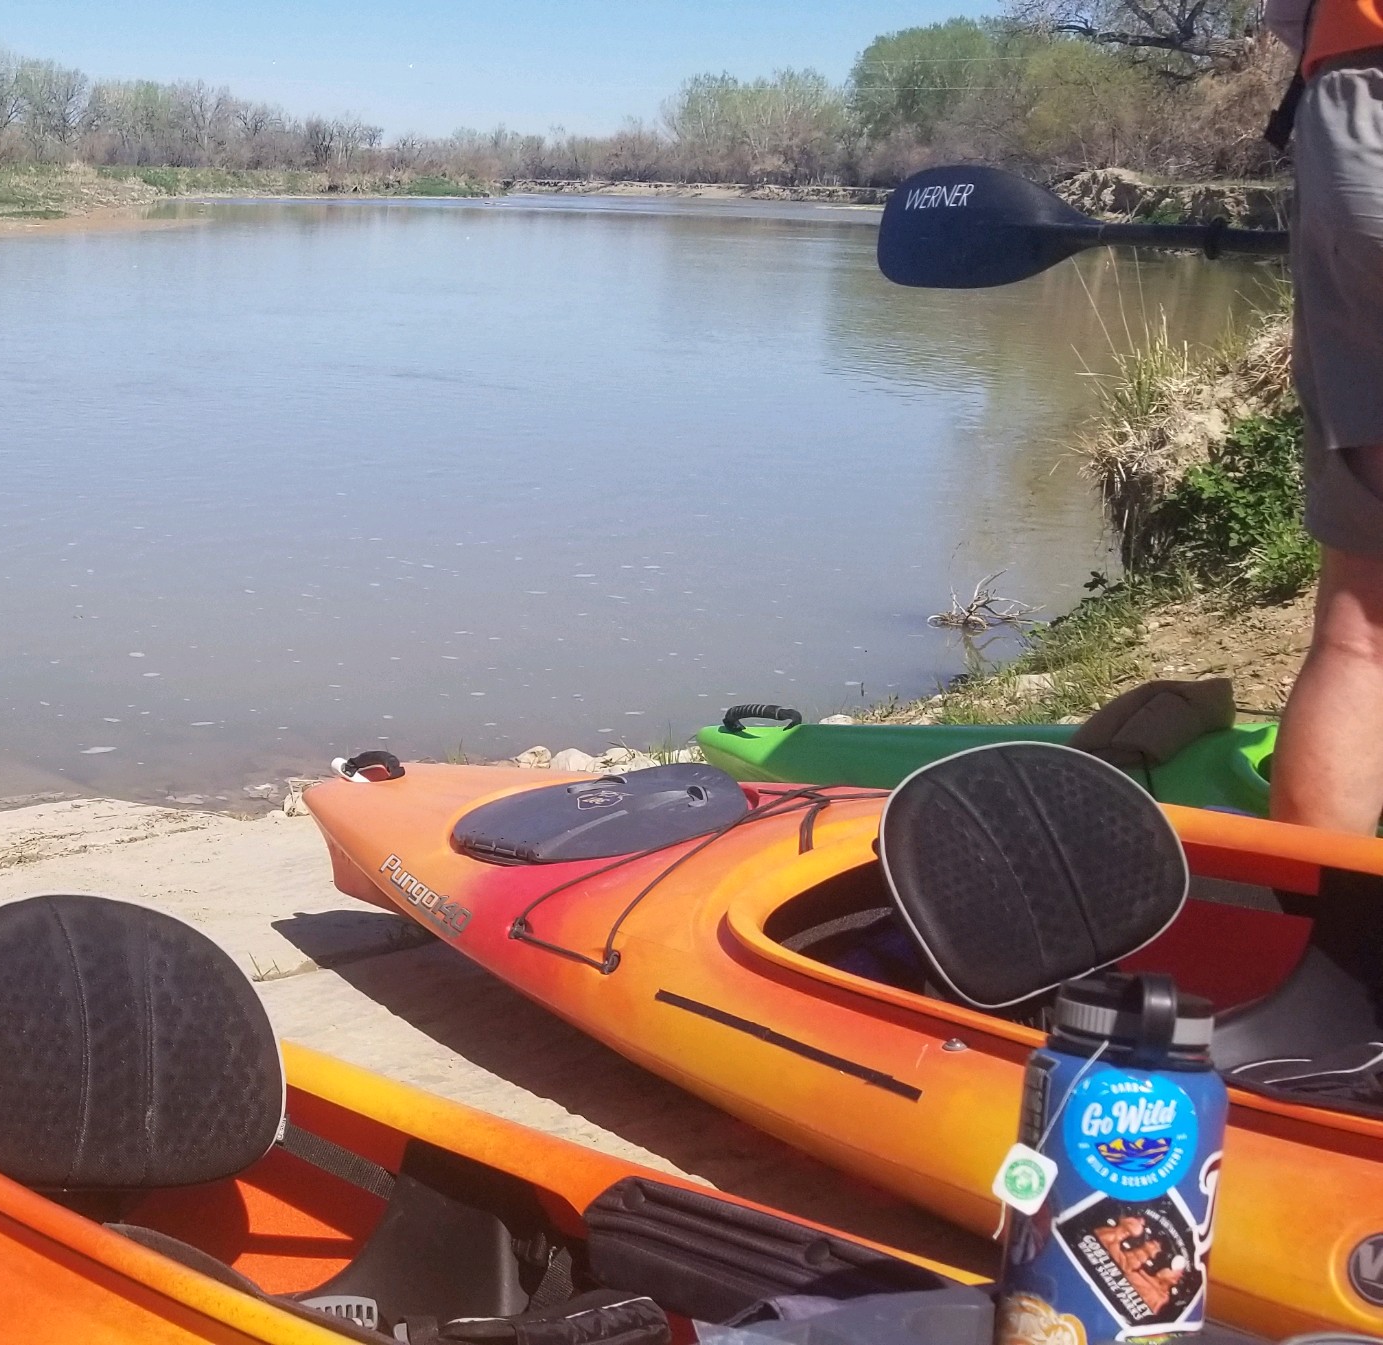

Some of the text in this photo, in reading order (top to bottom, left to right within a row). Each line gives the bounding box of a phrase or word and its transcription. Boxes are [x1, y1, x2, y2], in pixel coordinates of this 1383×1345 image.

[905, 184, 974, 210] WERNER
[1082, 1098, 1177, 1137] Go Wild
[1086, 1154, 1110, 1178] WILD
[1121, 1172, 1158, 1186] SCENIC
[1157, 1148, 1184, 1178] RIVERS
[1078, 1240, 1144, 1320] UTAH STATE PARKS
[1083, 1235, 1155, 1315] GOBLIN VALLEY
